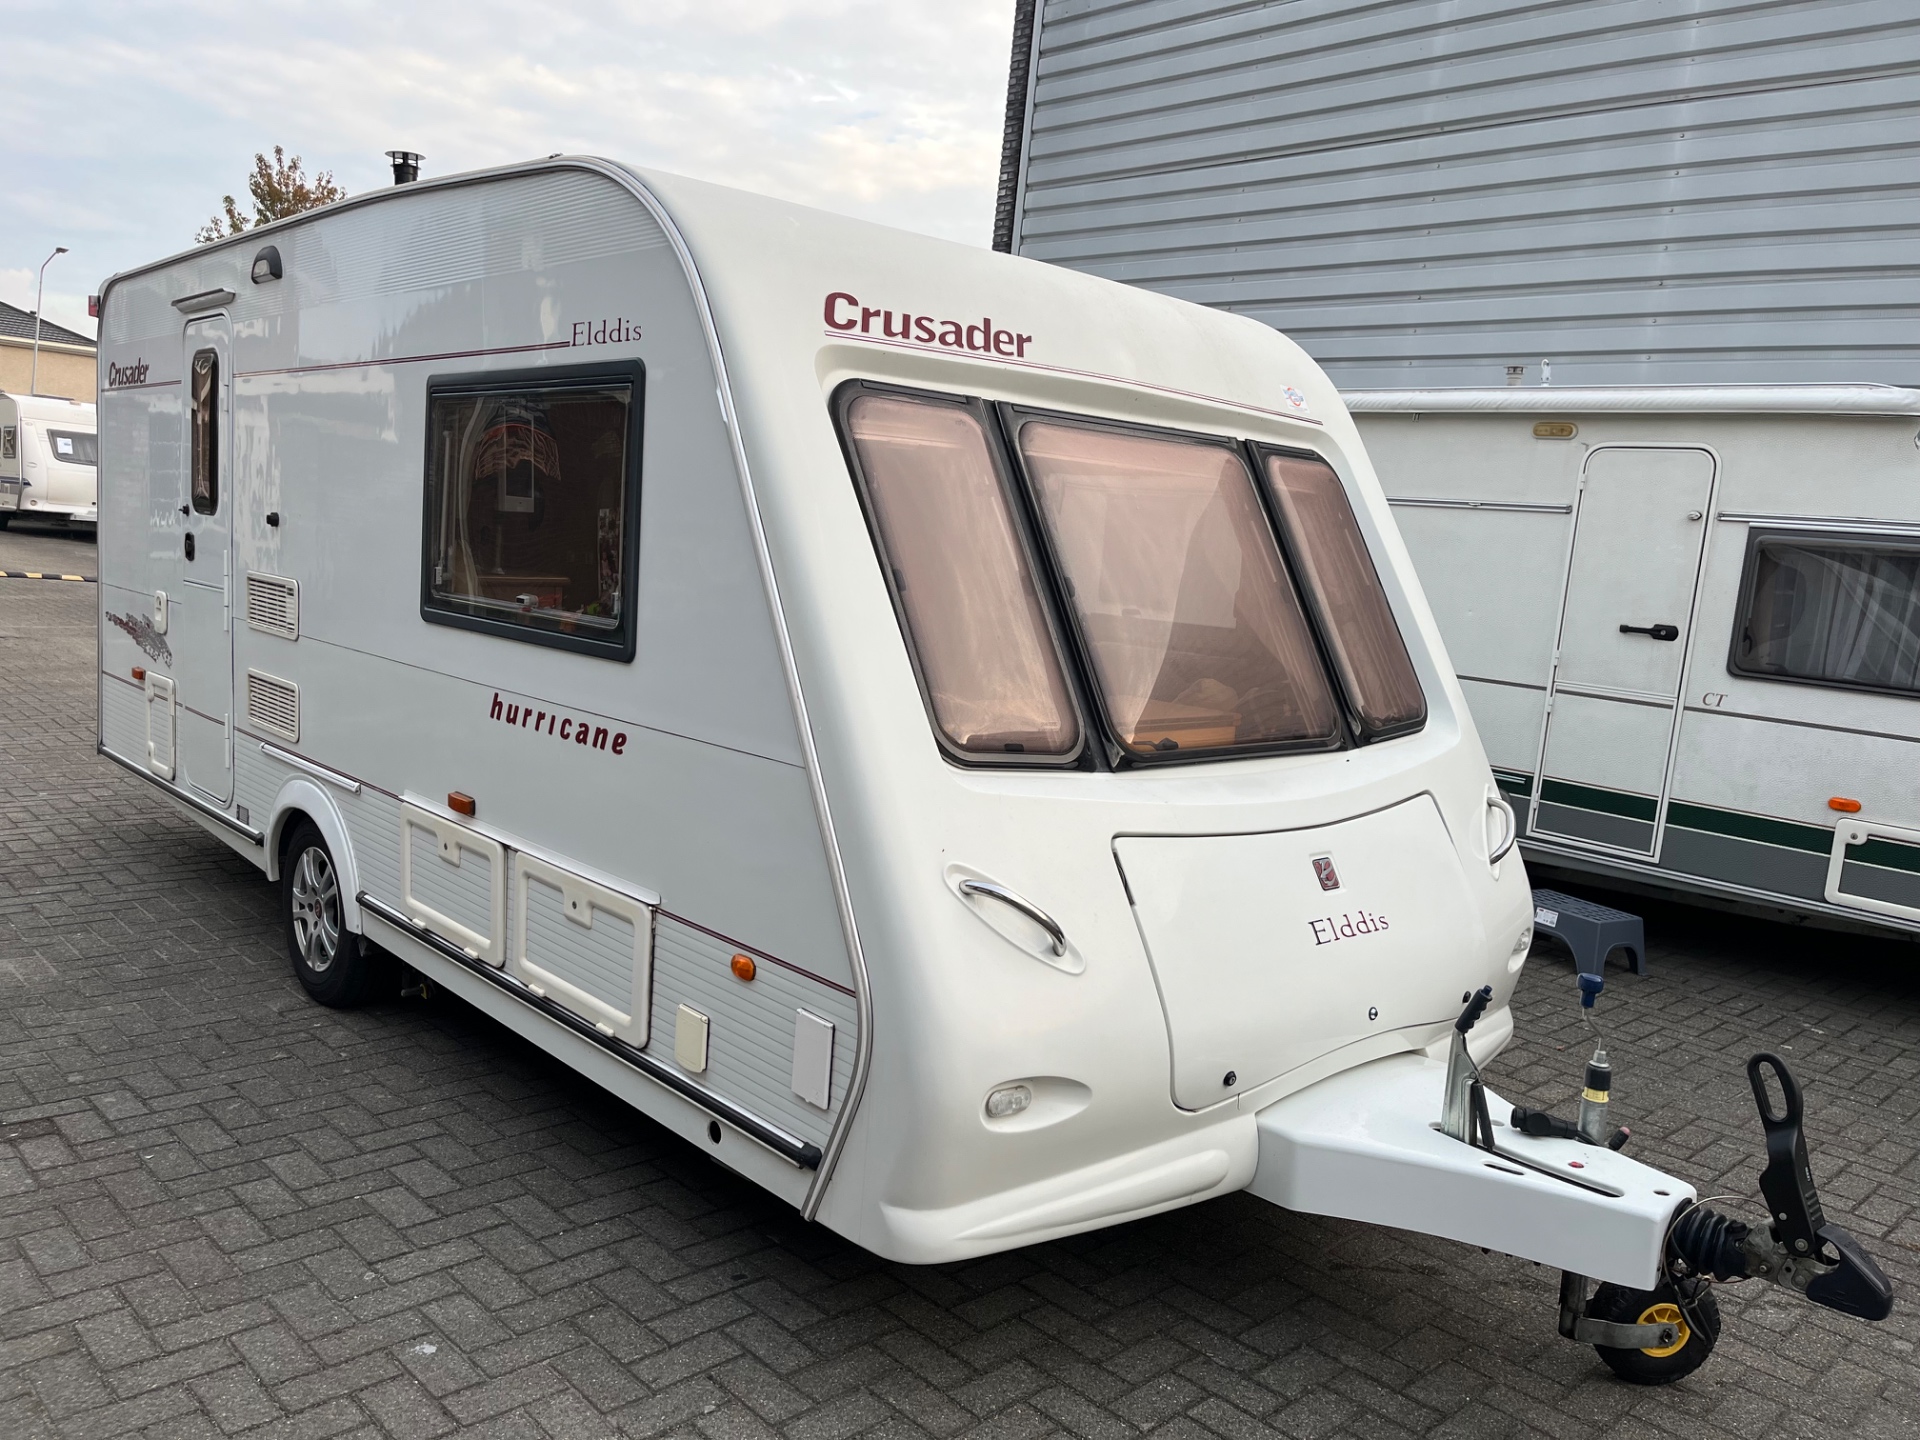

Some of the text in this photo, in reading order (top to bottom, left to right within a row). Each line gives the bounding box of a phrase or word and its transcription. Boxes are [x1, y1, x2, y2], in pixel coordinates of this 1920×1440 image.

[571, 317, 642, 347] Elddis
[824, 291, 1032, 358] Crusader
[109, 357, 149, 386] Crusader
[1702, 692, 1728, 708] CT
[490, 692, 628, 756] hurricane
[1307, 910, 1390, 946] Elddis
